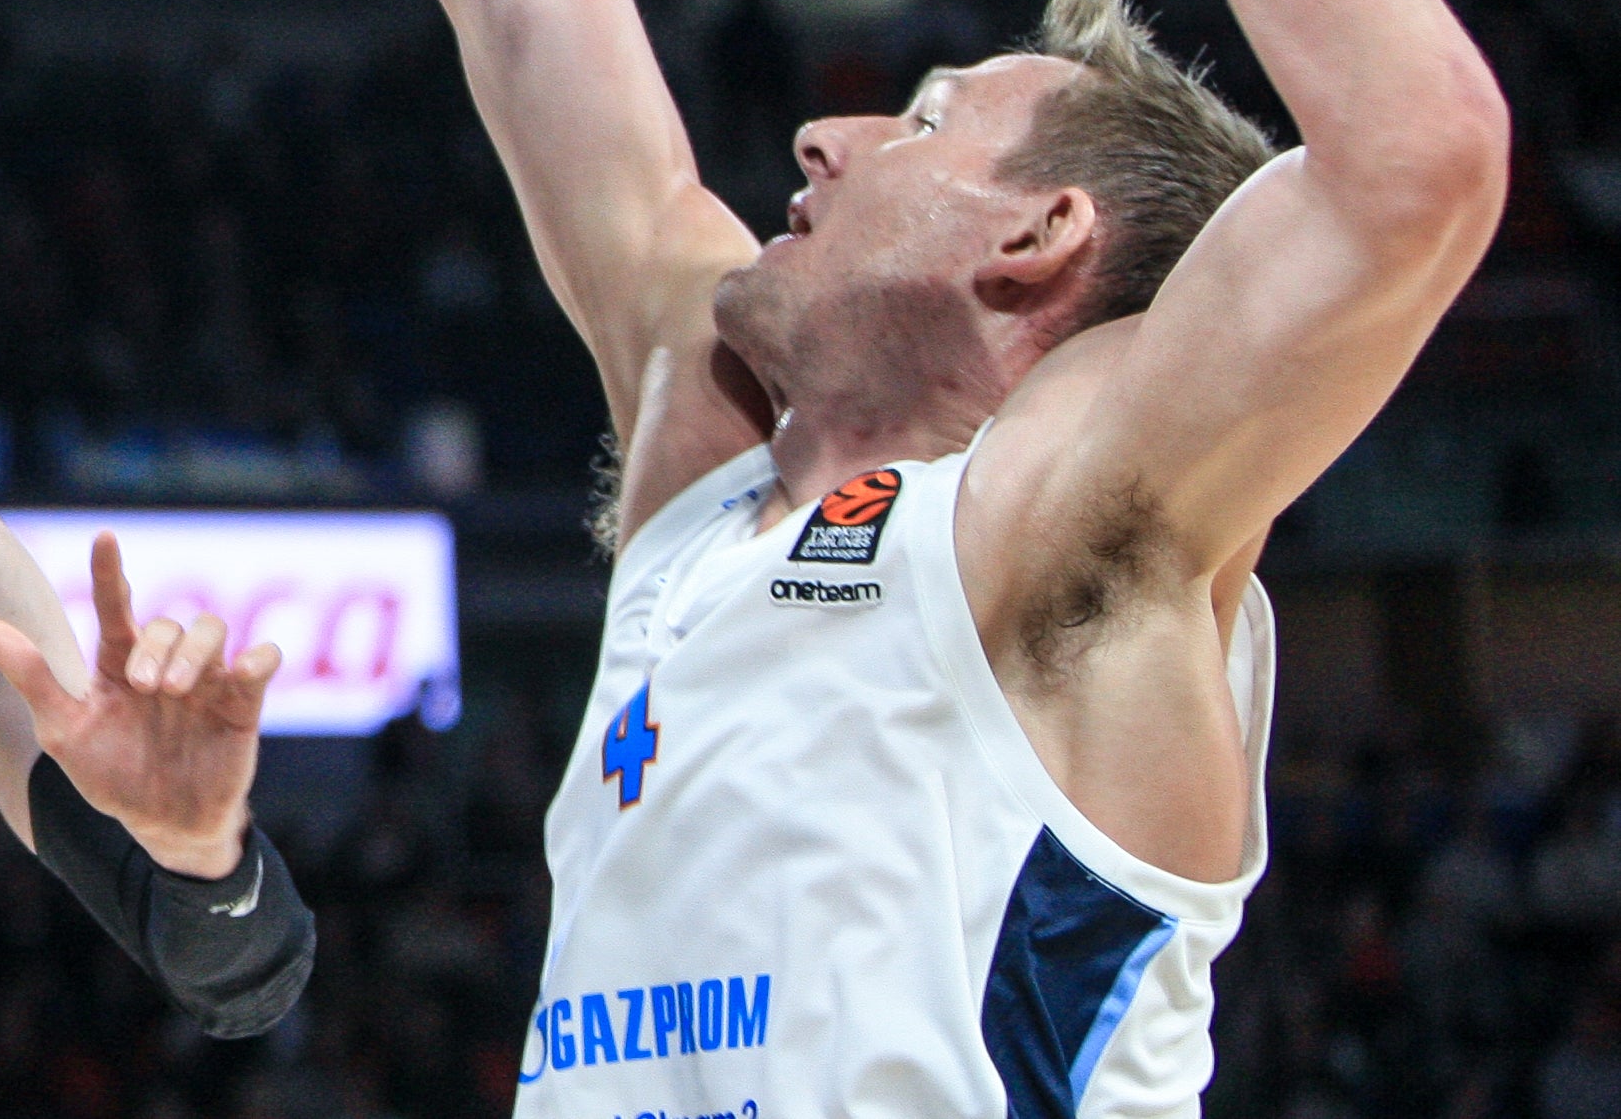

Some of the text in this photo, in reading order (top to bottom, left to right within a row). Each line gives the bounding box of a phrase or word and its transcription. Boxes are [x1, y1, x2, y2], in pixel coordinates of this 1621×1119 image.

[770, 579, 881, 602] oneteam
[603, 681, 660, 809] 4
[551, 973, 771, 1071] GAZPROM
